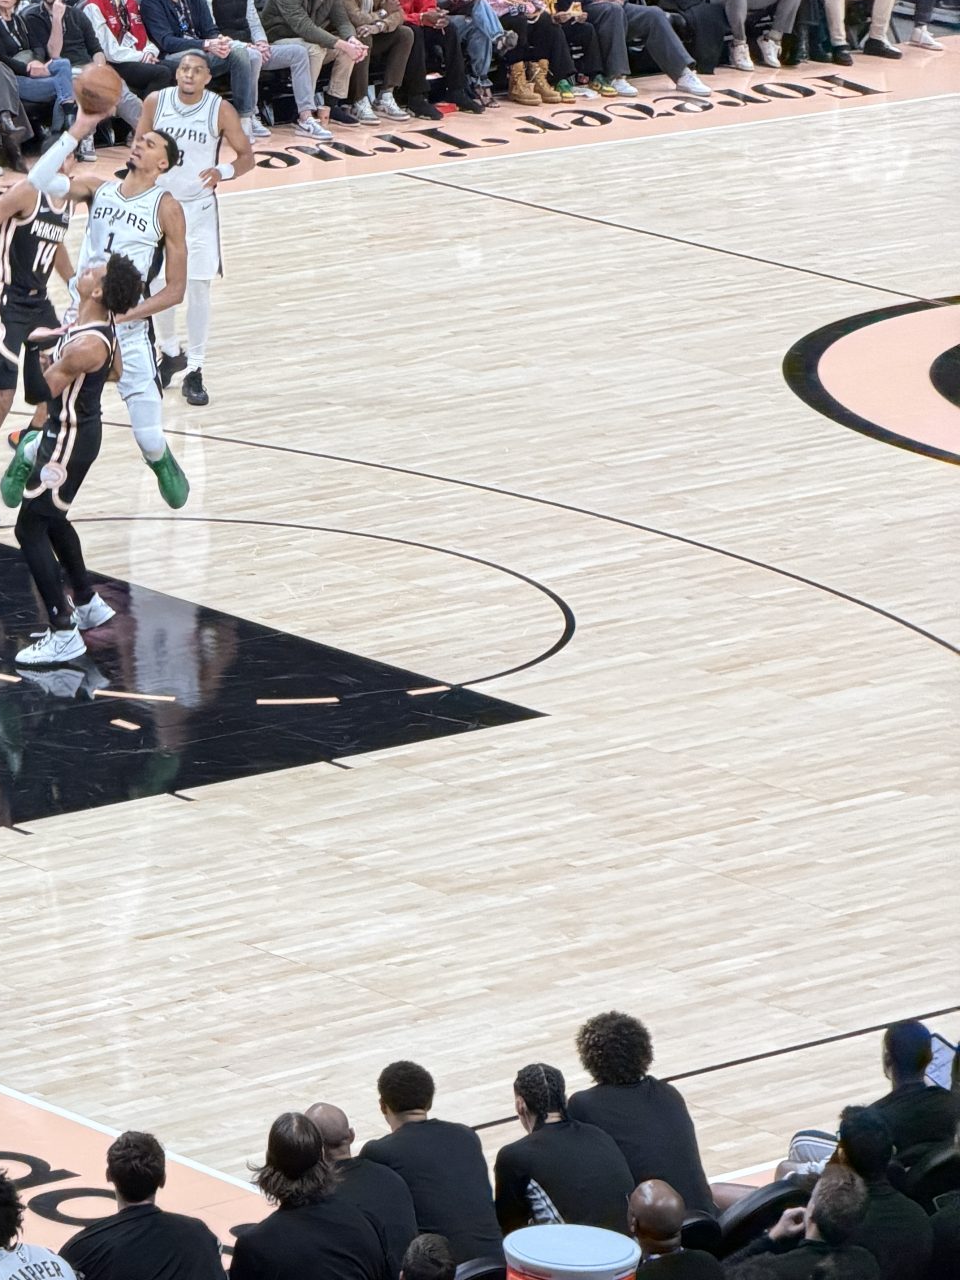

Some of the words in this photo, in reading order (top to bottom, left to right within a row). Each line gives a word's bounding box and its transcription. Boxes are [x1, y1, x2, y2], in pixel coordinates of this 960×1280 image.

[516, 73, 894, 135] Forever
[253, 123, 510, 170] True
[93, 206, 148, 232] SPURS
[32, 241, 58, 274] 14
[103, 232, 115, 253] 1
